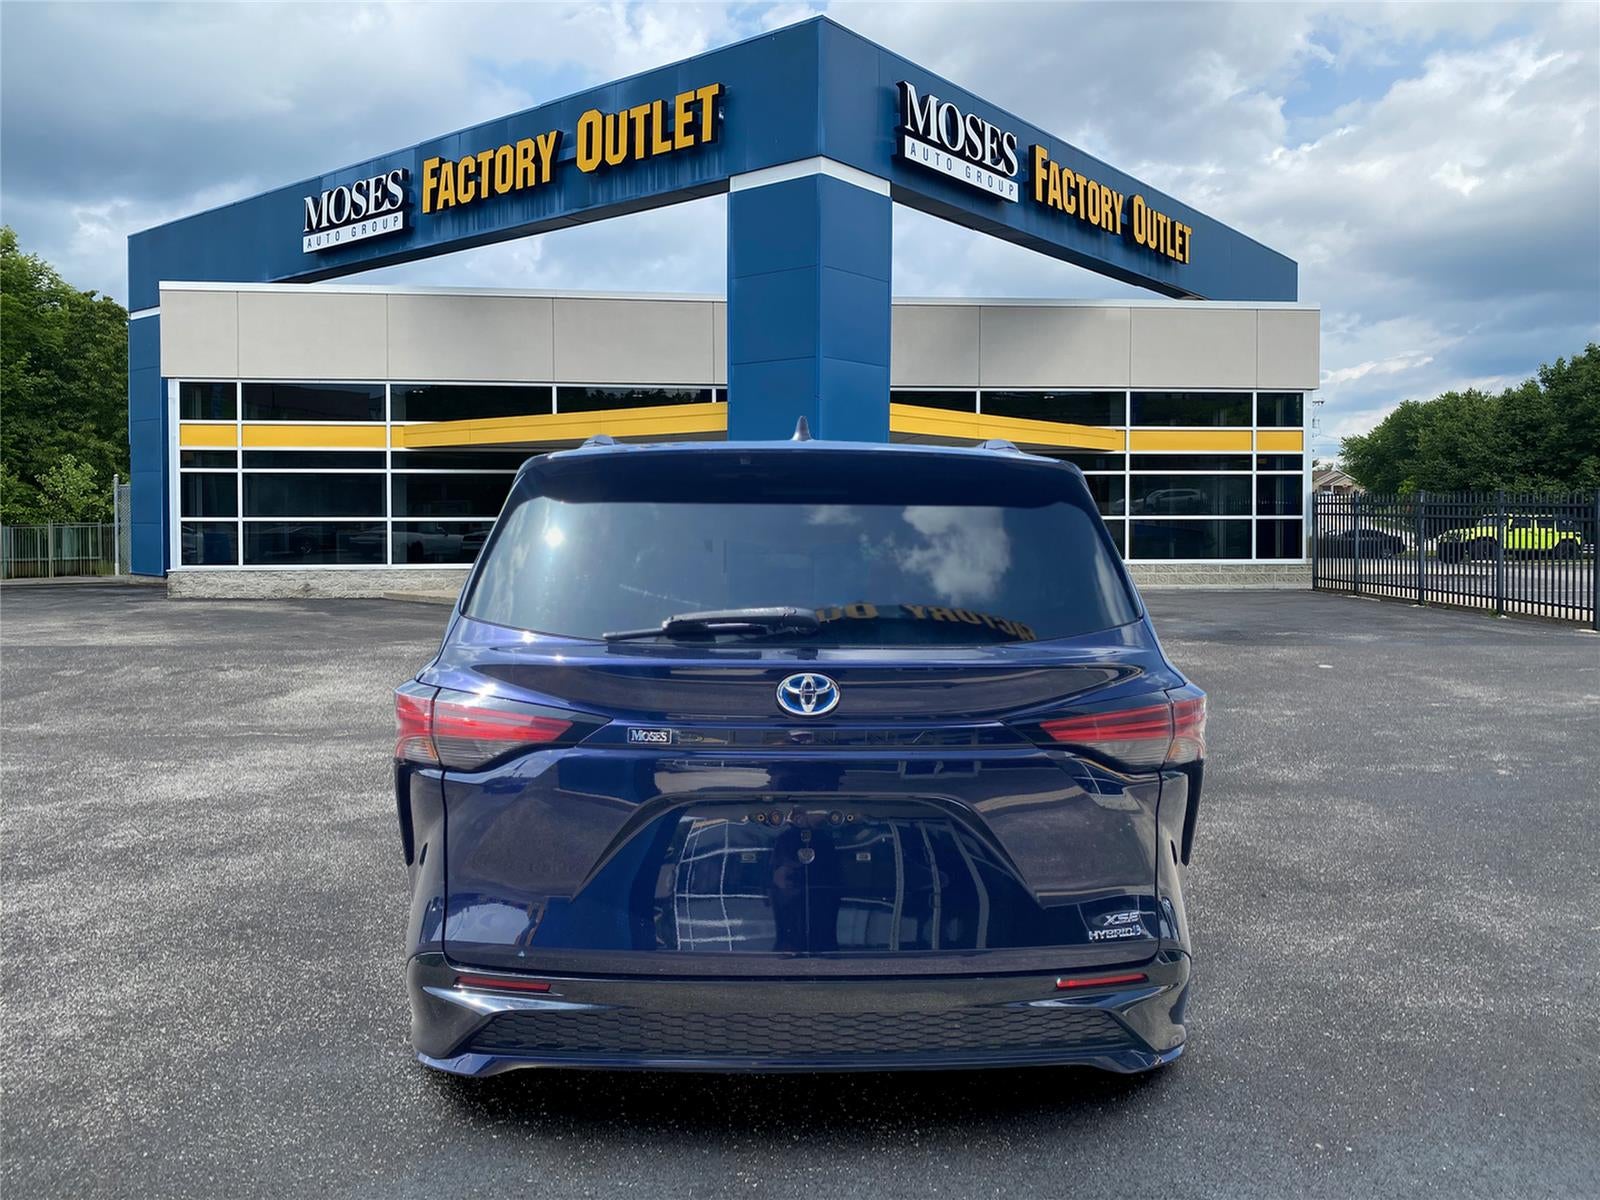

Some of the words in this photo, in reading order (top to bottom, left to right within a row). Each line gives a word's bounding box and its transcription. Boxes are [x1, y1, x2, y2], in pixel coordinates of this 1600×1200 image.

[422, 131, 558, 214] FACTORY
[576, 83, 721, 173] OUTLET
[904, 80, 1019, 178] MOSES
[910, 141, 953, 172] AUTO
[964, 165, 1015, 196] GROUP
[303, 169, 404, 232] MOSES
[1034, 143, 1124, 236] FACTORY
[1132, 193, 1192, 264] OUTLET
[307, 230, 341, 249] AUTO
[351, 215, 399, 238] GROUP
[631, 730, 667, 741] MOSES
[1103, 911, 1140, 926] XSE
